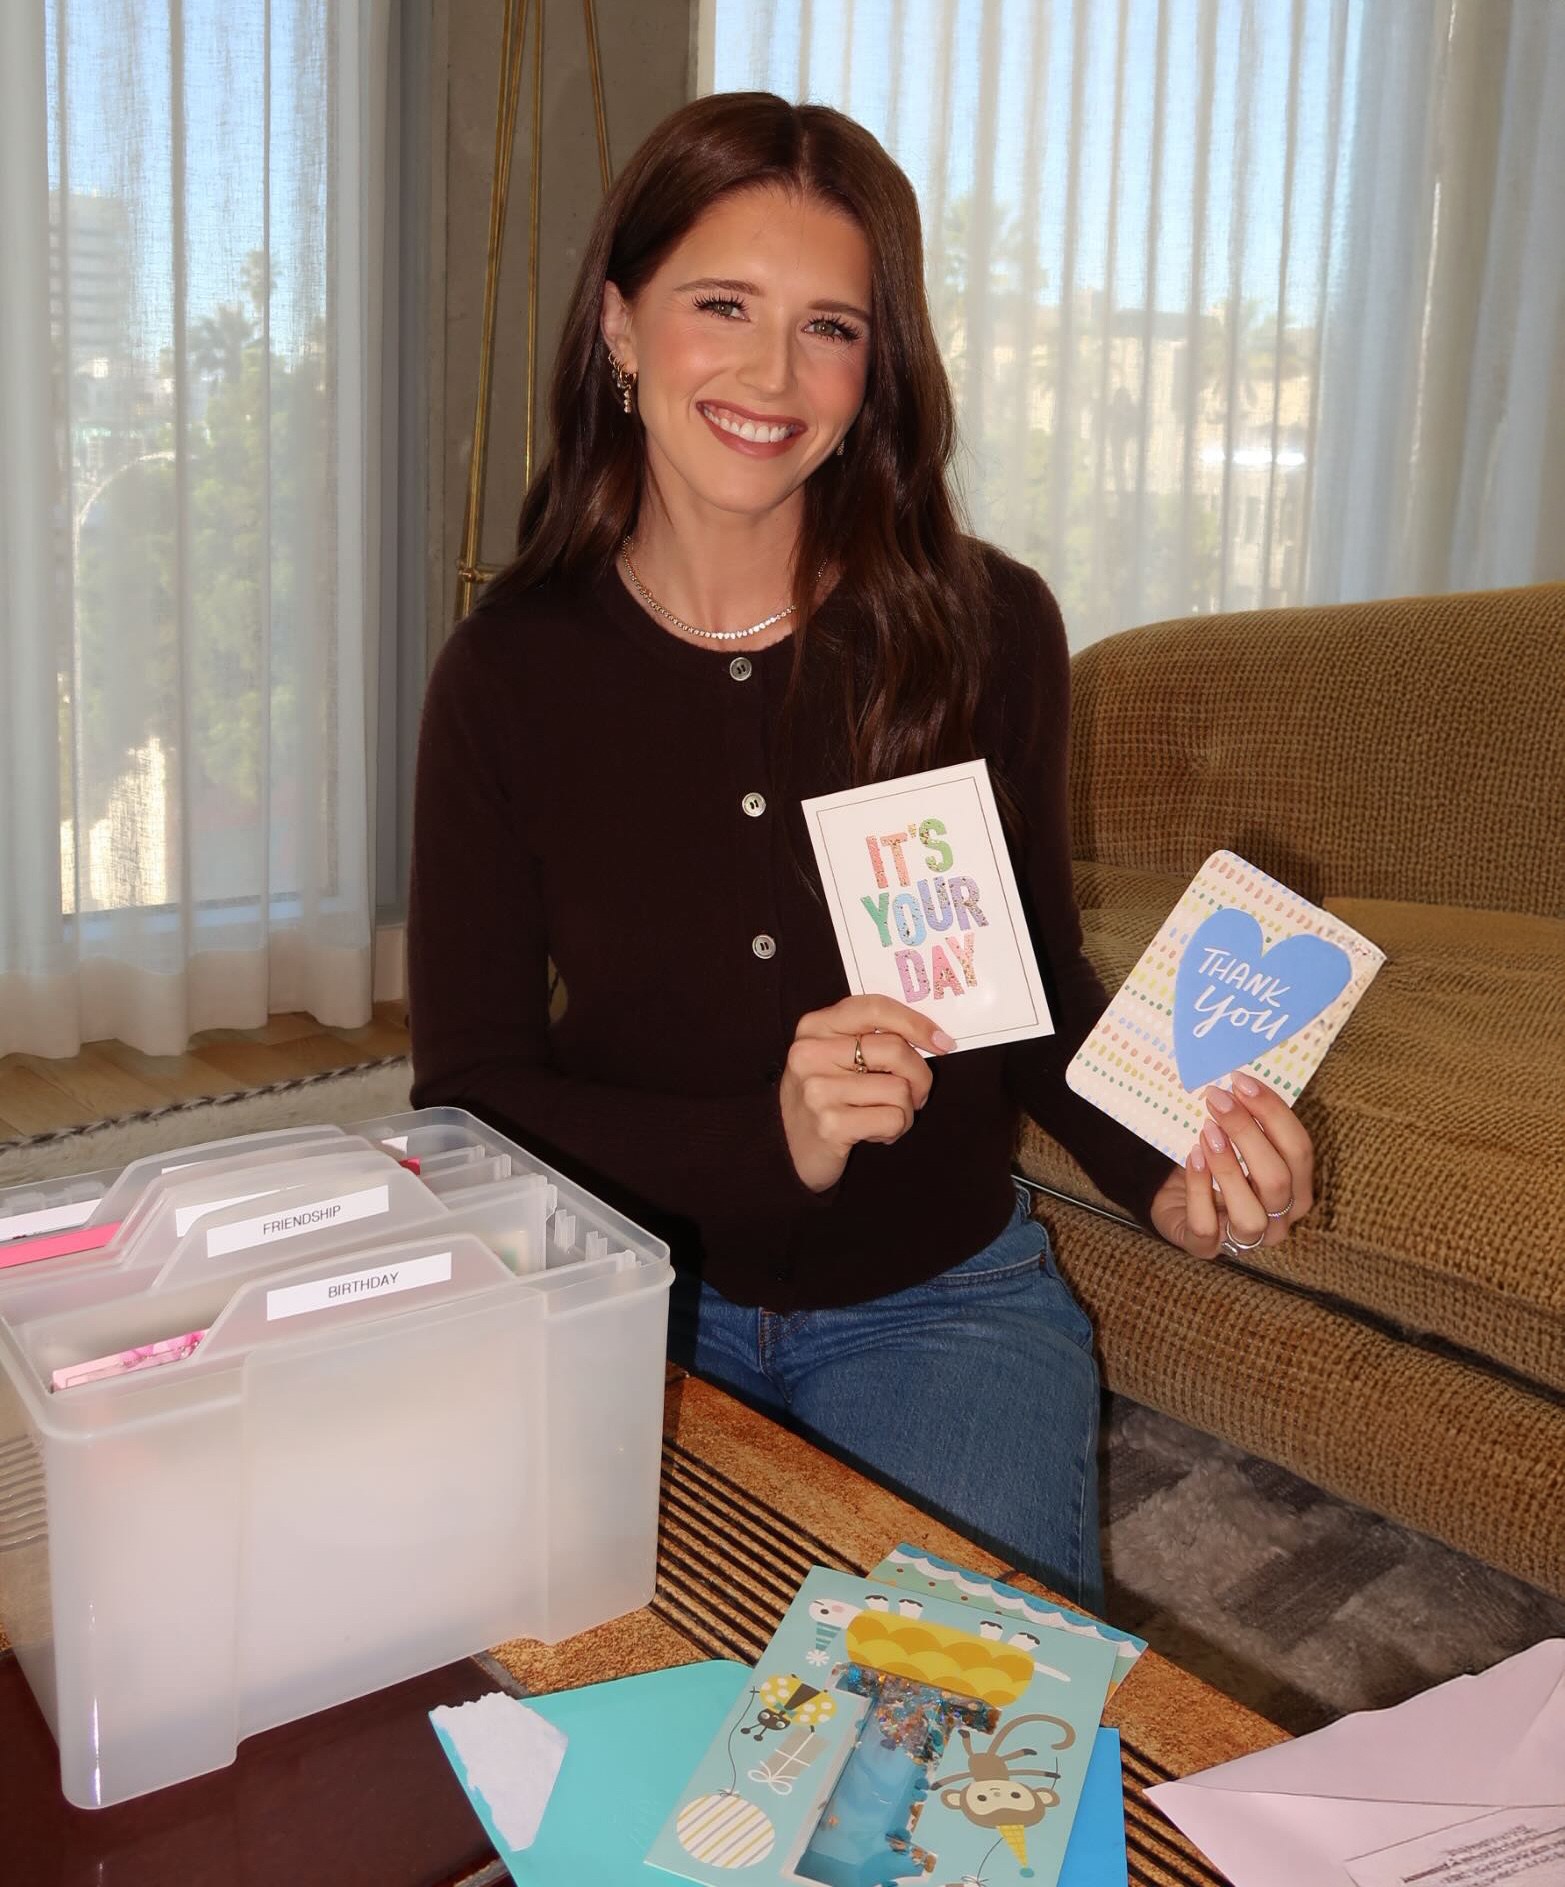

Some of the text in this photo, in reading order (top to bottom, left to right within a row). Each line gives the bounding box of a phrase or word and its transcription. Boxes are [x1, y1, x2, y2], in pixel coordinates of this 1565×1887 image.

[866, 818, 954, 889] IT'S
[860, 875, 989, 947] YOUR
[895, 932, 977, 1003] DAY
[1198, 947, 1291, 1008] THANK
[263, 1205, 341, 1235] FRIENDSHIP
[328, 1271, 400, 1299] BIRTHDAY
